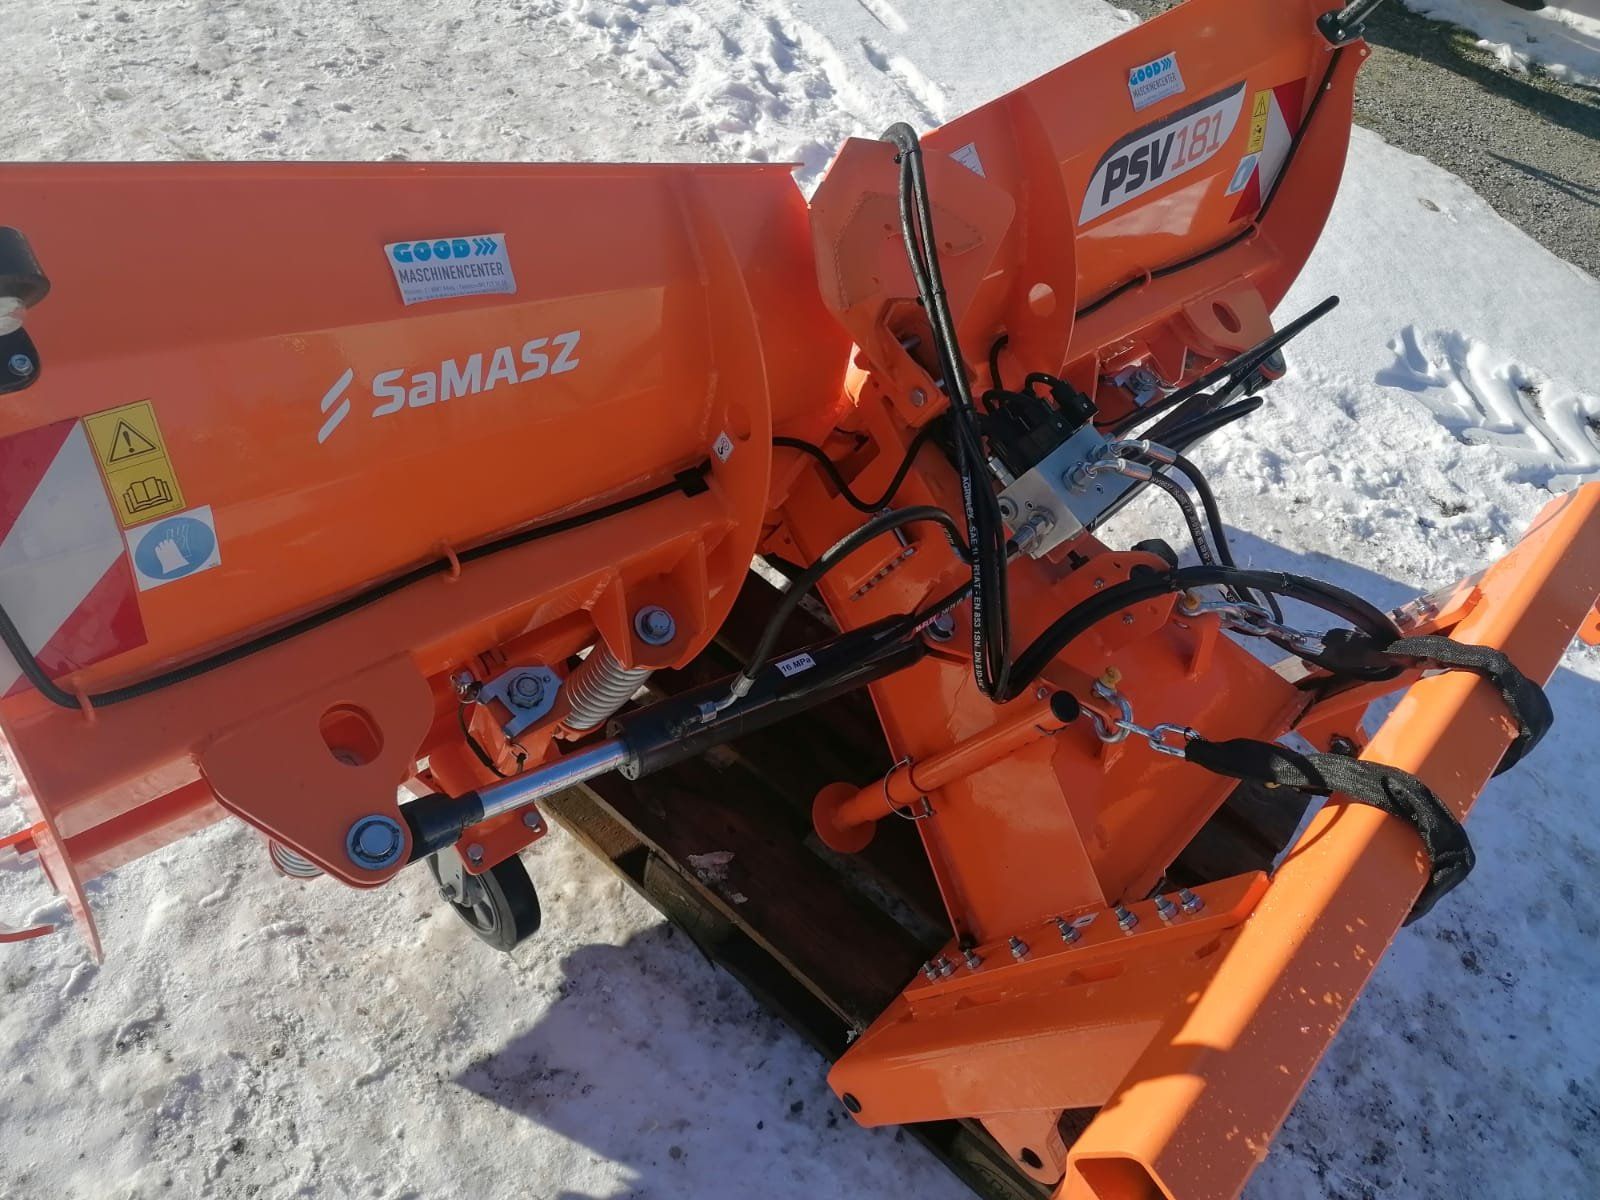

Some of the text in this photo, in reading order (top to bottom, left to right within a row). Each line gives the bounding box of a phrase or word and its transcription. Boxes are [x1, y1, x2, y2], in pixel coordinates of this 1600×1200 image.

[1130, 61, 1161, 85] GOOD
[393, 238, 471, 263] GOOD
[398, 262, 505, 284] MASCHINENCENTER
[372, 329, 581, 418] SaMASZ
[969, 526, 978, 545] SAE
[973, 597, 981, 610] EN
[973, 612, 981, 628] 853
[973, 630, 981, 648] 1SN
[782, 658, 811, 672] 16 MPa
[974, 651, 981, 664] DN
